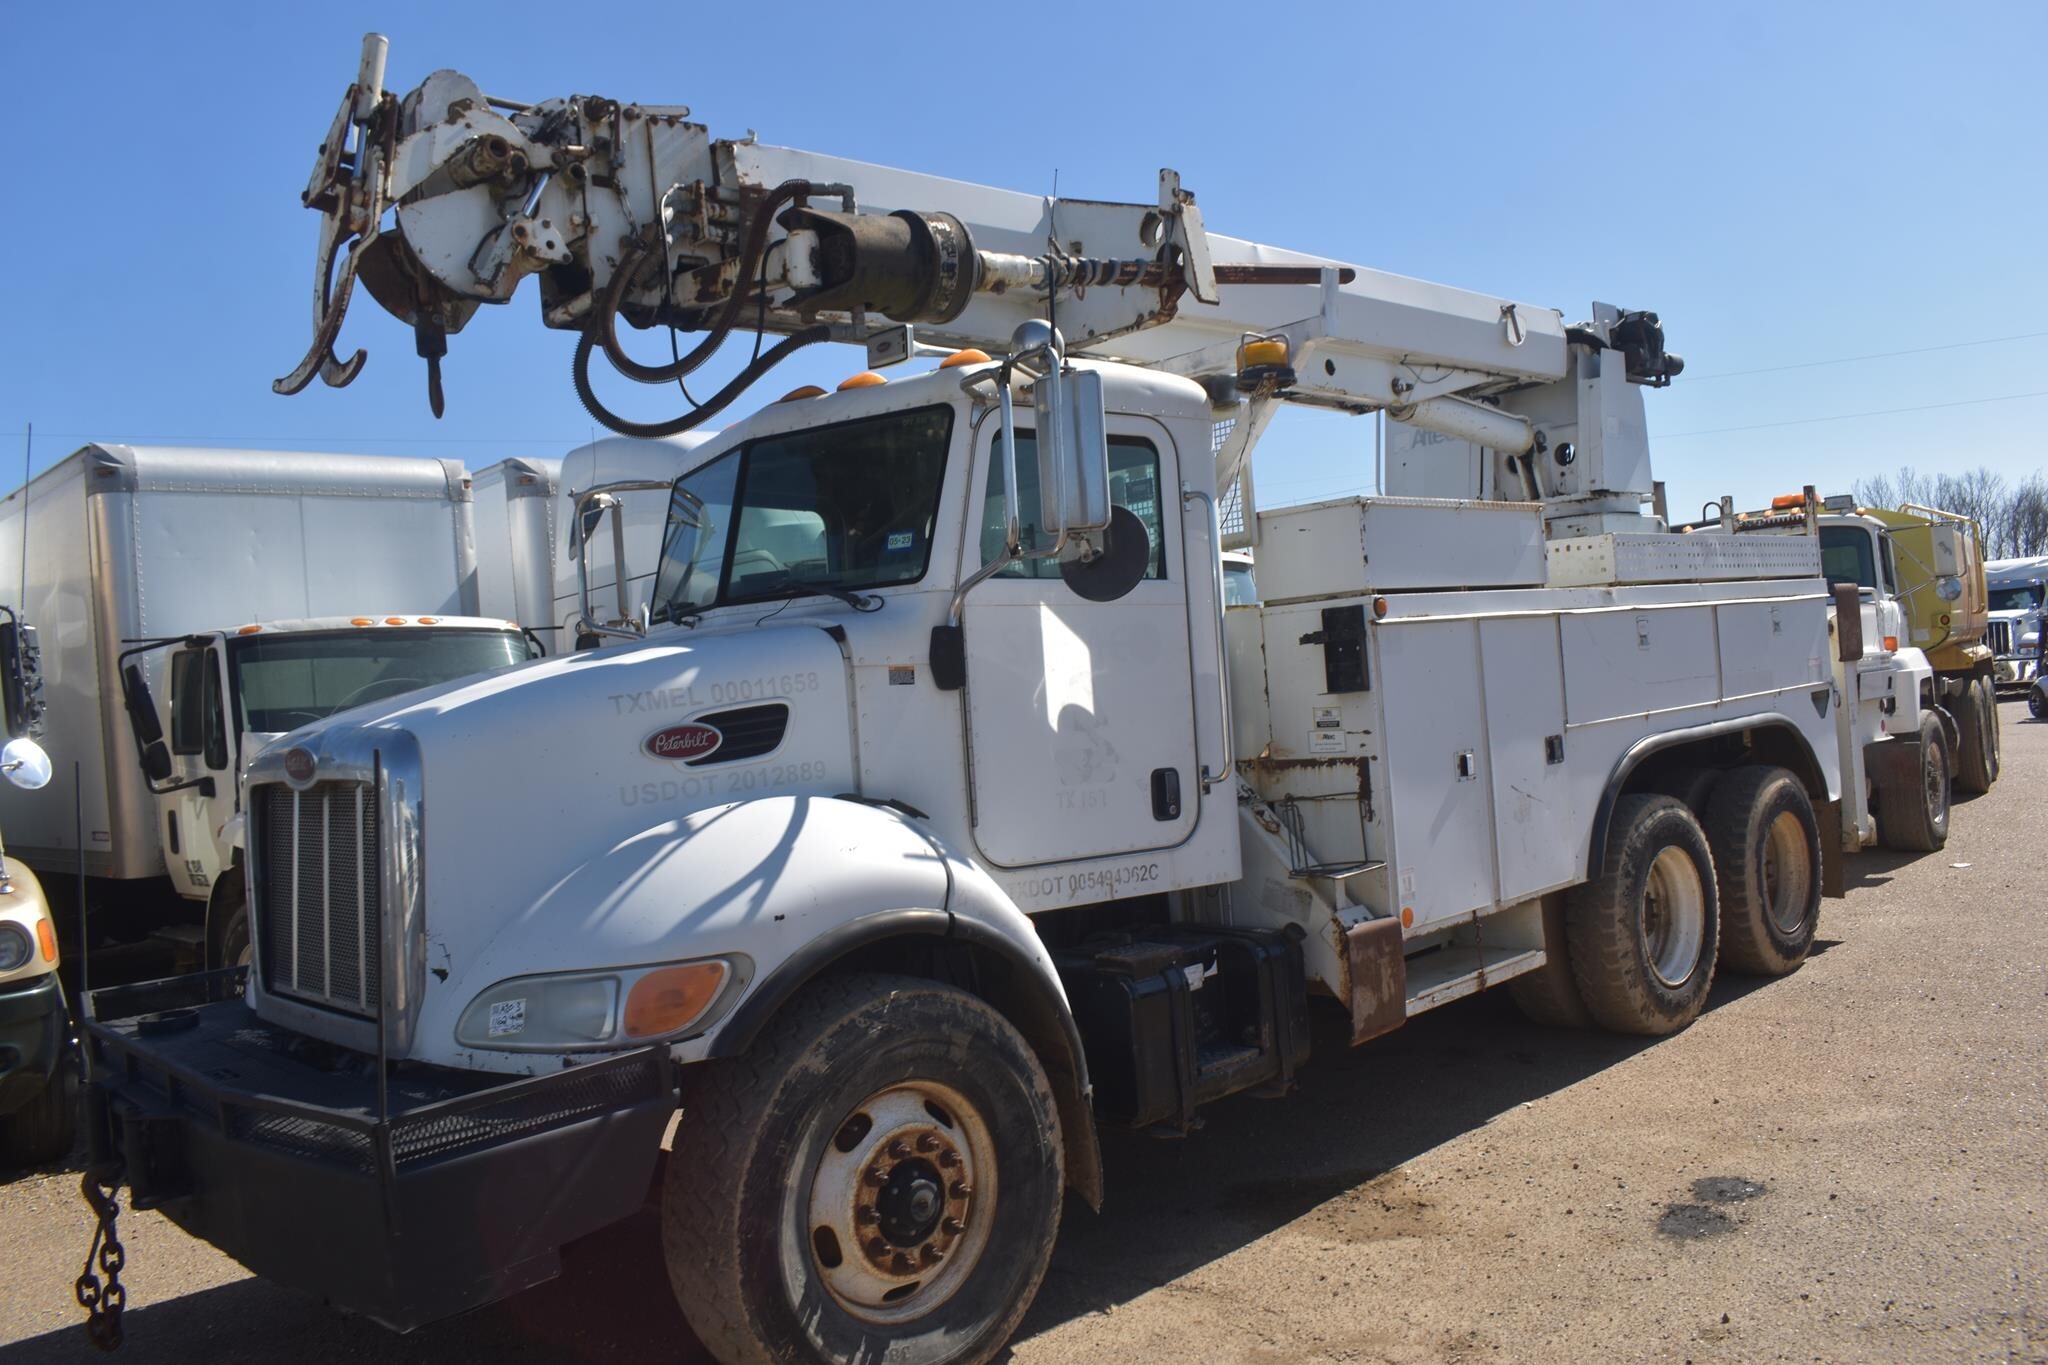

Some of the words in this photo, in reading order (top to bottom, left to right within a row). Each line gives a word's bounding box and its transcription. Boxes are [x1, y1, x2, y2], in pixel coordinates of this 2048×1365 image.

[608, 686, 704, 716] TXMEL
[710, 672, 820, 703] 00011658
[655, 731, 713, 754] Peterbilt
[619, 776, 719, 807] USDOT
[728, 760, 826, 794] 2012889
